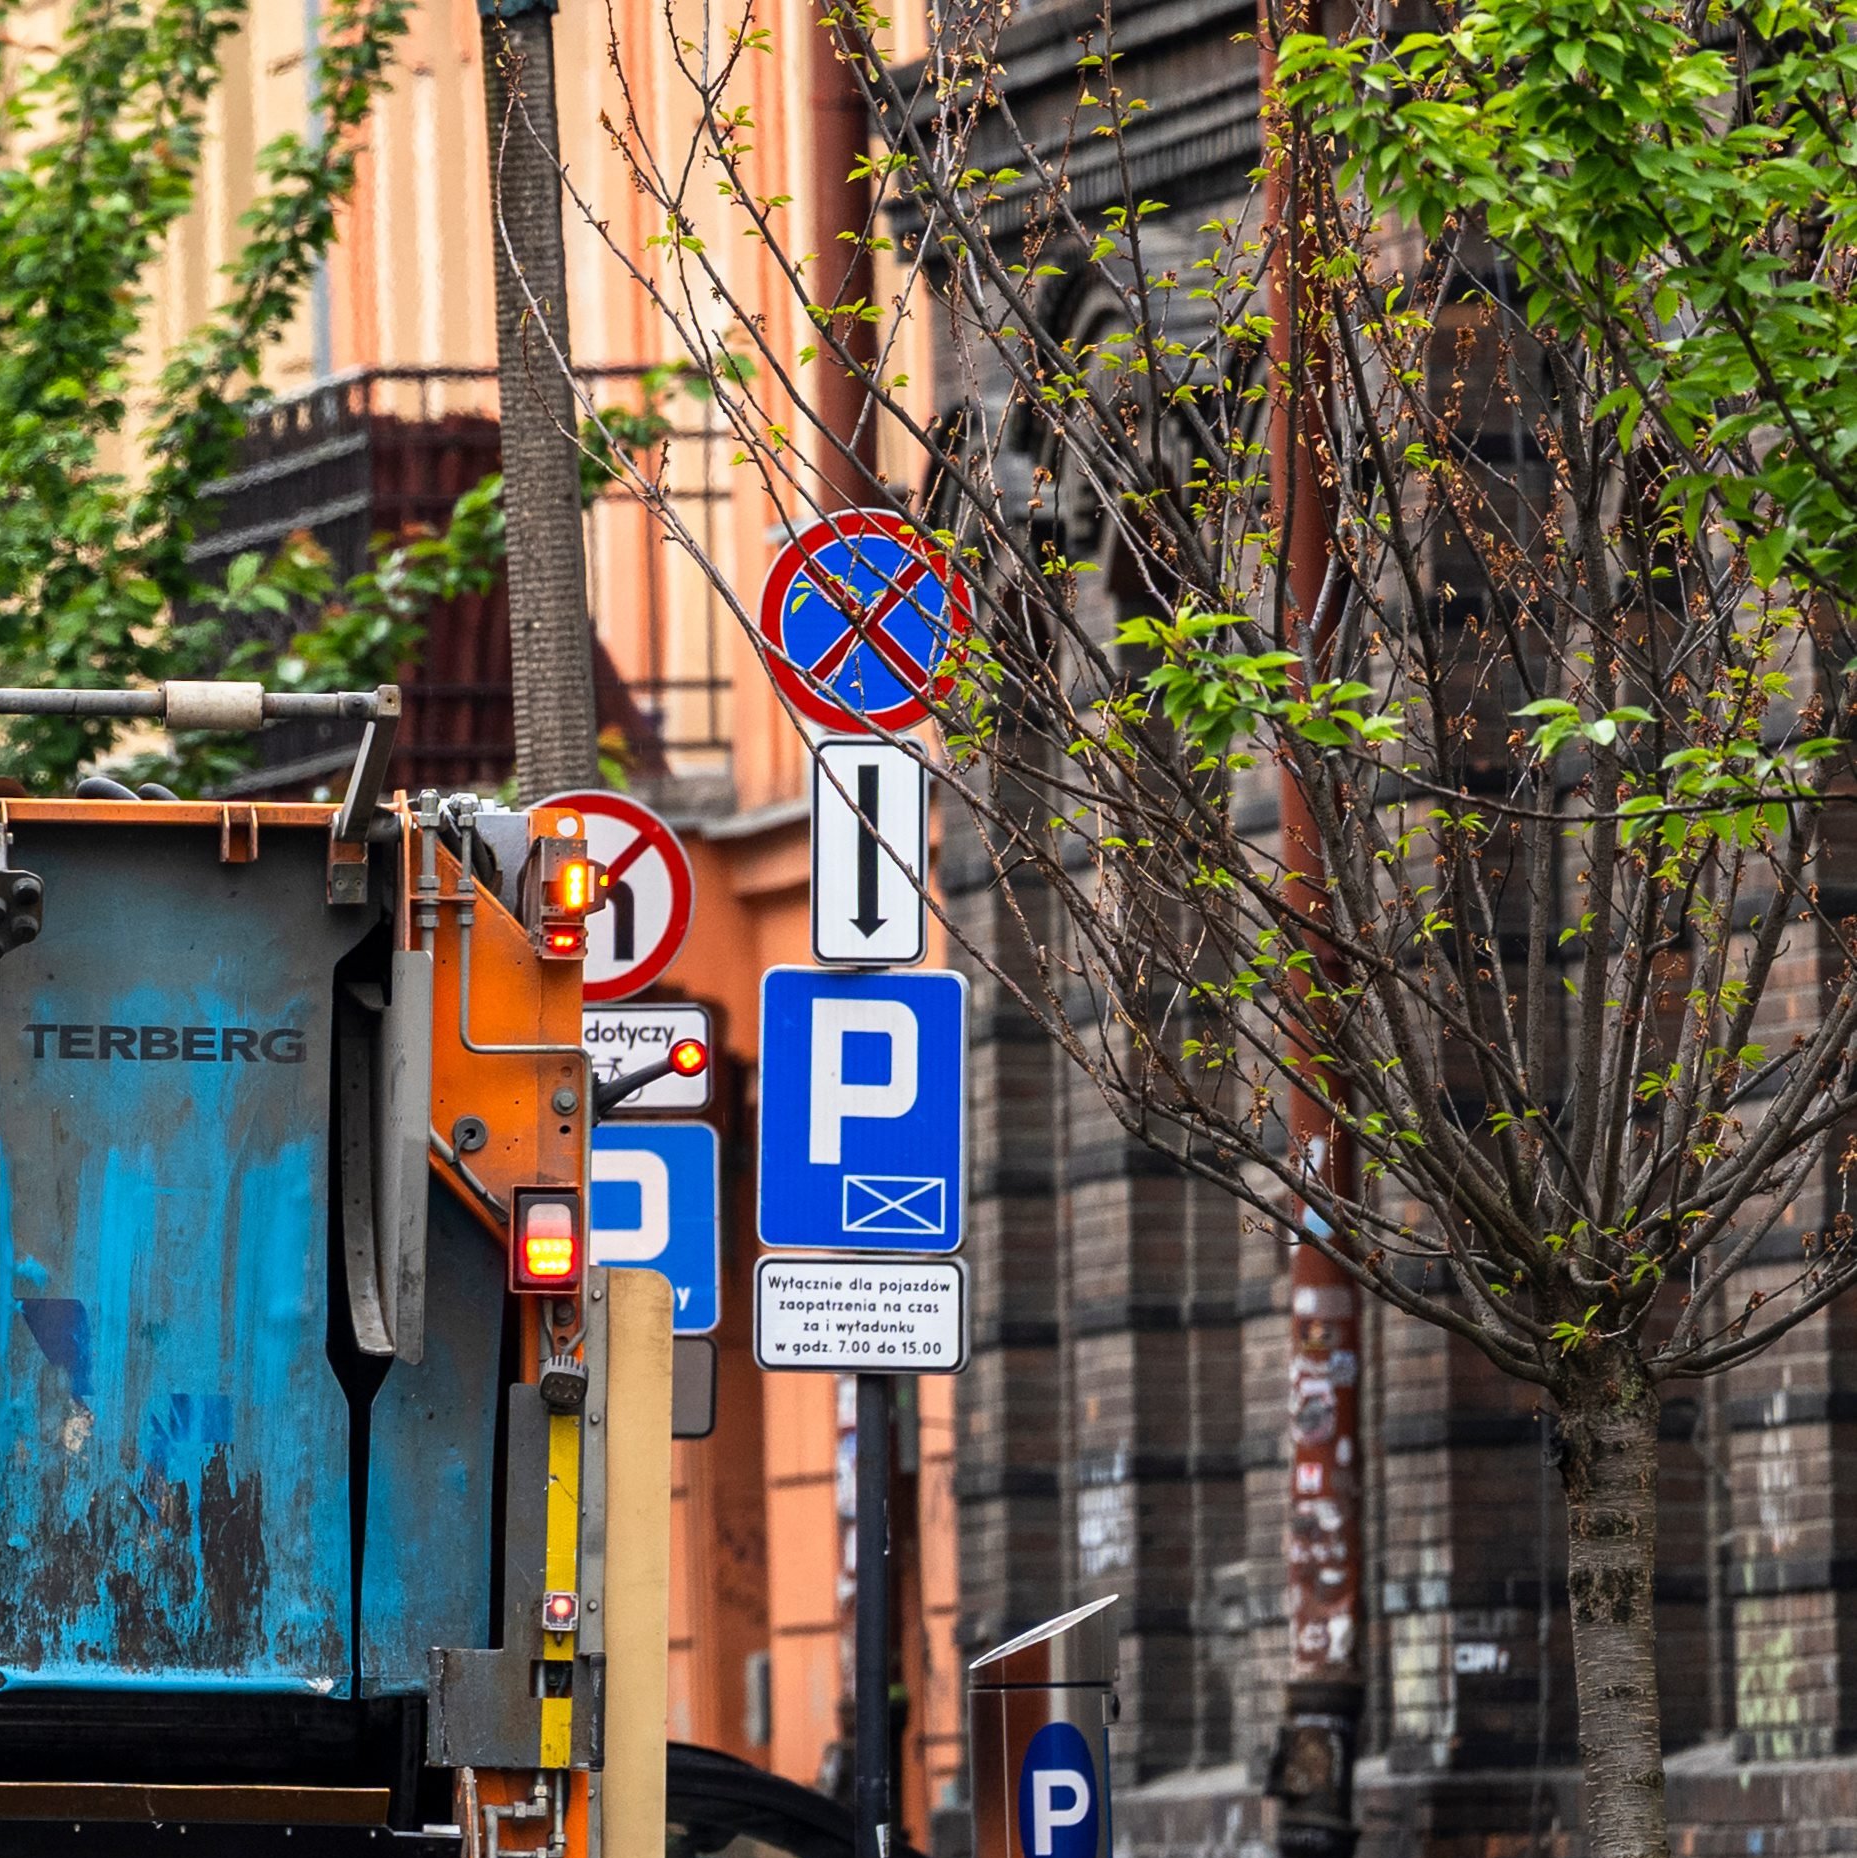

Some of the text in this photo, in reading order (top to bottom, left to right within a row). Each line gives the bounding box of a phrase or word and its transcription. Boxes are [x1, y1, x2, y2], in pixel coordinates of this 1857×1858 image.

[21, 1023, 307, 1064] TERBERG
[584, 1019, 675, 1050] dotyczy
[810, 997, 920, 1167] P
[767, 1276, 951, 1295] Wyłącznie dla pojazdów
[779, 1299, 939, 1315] zaopatrzenia na czas
[803, 1318, 915, 1336] za i wyładunku
[775, 1340, 942, 1357] w godz. 7.00 do 15.00
[1032, 1769, 1092, 1858] P
